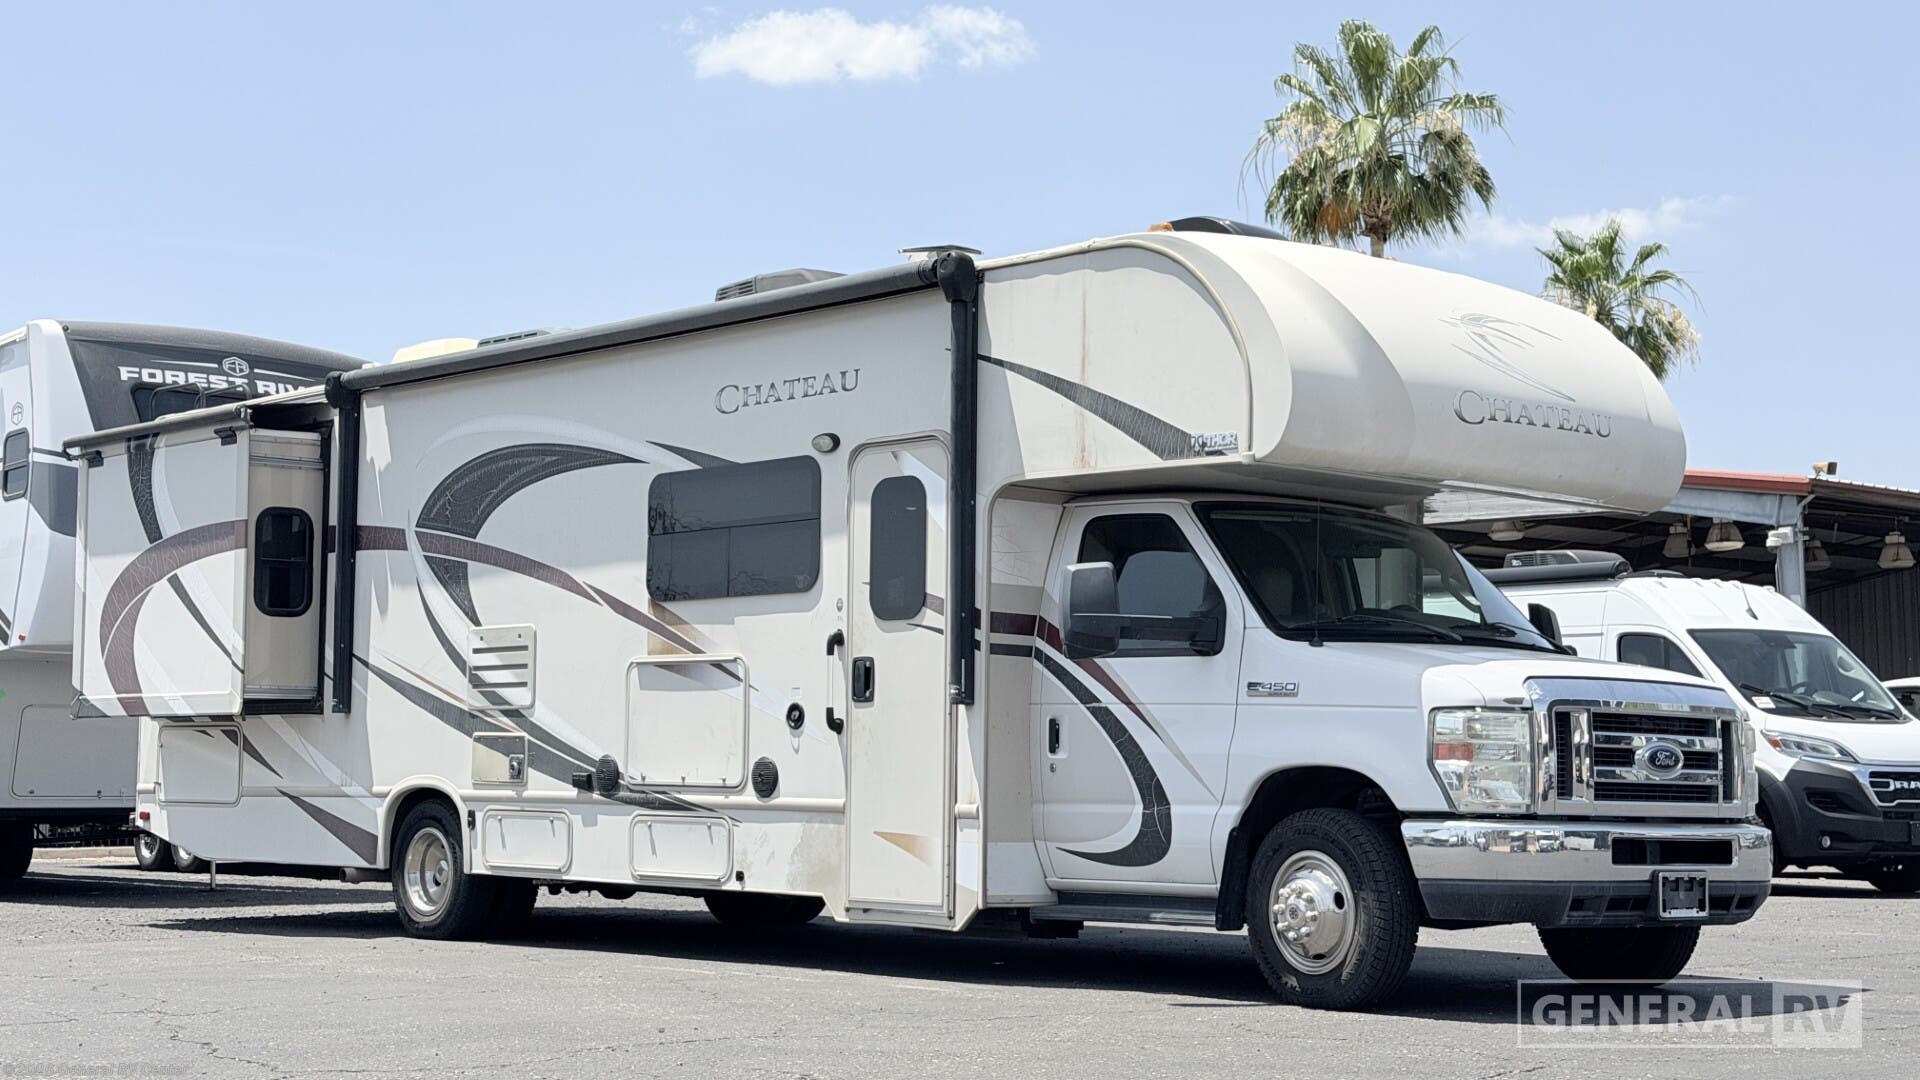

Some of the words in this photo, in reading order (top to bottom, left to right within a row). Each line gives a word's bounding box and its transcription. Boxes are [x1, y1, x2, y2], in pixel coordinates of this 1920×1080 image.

[117, 366, 249, 391] FOREST
[715, 368, 861, 414] CHATEAU
[1453, 390, 1612, 438] CHATEAU
[1205, 432, 1238, 448] THOR
[1655, 751, 1676, 766] Ford
